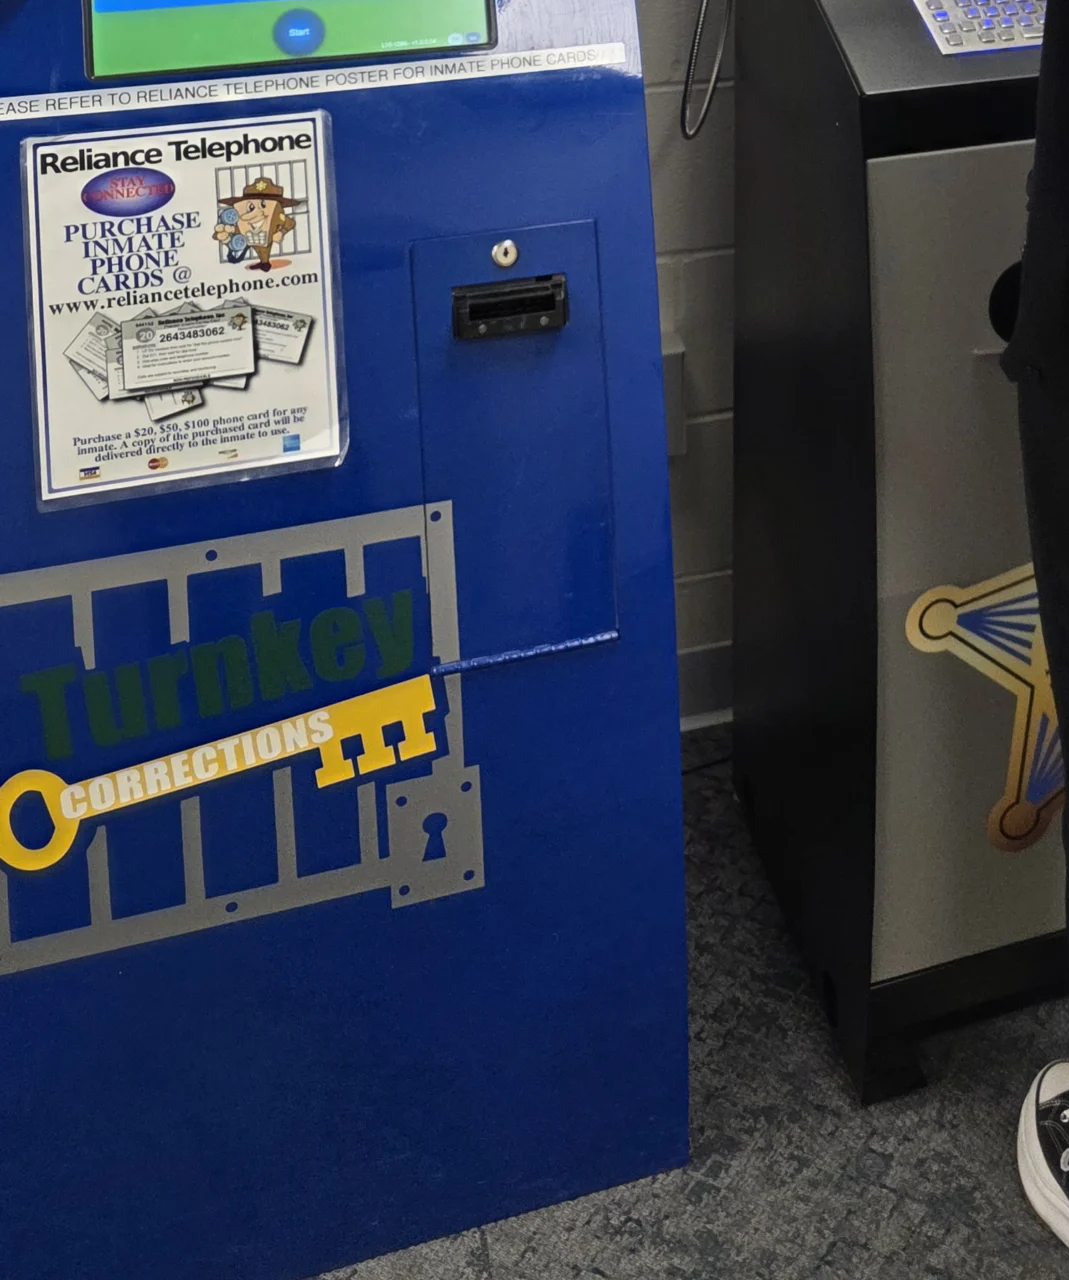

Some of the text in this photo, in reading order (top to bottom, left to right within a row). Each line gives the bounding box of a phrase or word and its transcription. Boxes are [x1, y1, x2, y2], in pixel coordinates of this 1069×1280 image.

[289, 27, 311, 37] Start
[45, 94, 103, 111] REFER
[110, 91, 132, 106] TO
[137, 84, 219, 103] RELIANCE
[225, 76, 320, 96] TELEPHONE
[325, 70, 389, 87] POSTER
[393, 66, 425, 82] FOR
[430, 60, 486, 77] INMATE
[491, 56, 543, 70] PHONE
[546, 50, 597, 65] CARDS
[40, 133, 312, 175] Reliance Telephone
[82, 183, 175, 202] CONNECTED
[110, 176, 145, 189] STAY
[64, 211, 201, 243] PURCHASE
[82, 230, 185, 259] INMATE
[90, 249, 179, 276] PHONE
[49, 271, 319, 316] www.reliancetelephone.com
[77, 266, 192, 296] CARDS @
[139, 326, 225, 343] 20 2643483062
[73, 405, 308, 447] Purchase a $20, $50, $100 phone card for any
[77, 414, 305, 456] inmate. A copy of the purchased card will be
[94, 426, 290, 463] delivered directly to the inmate to use.
[20, 589, 414, 761] Turnkey
[60, 711, 334, 820] CORRECTIONS
